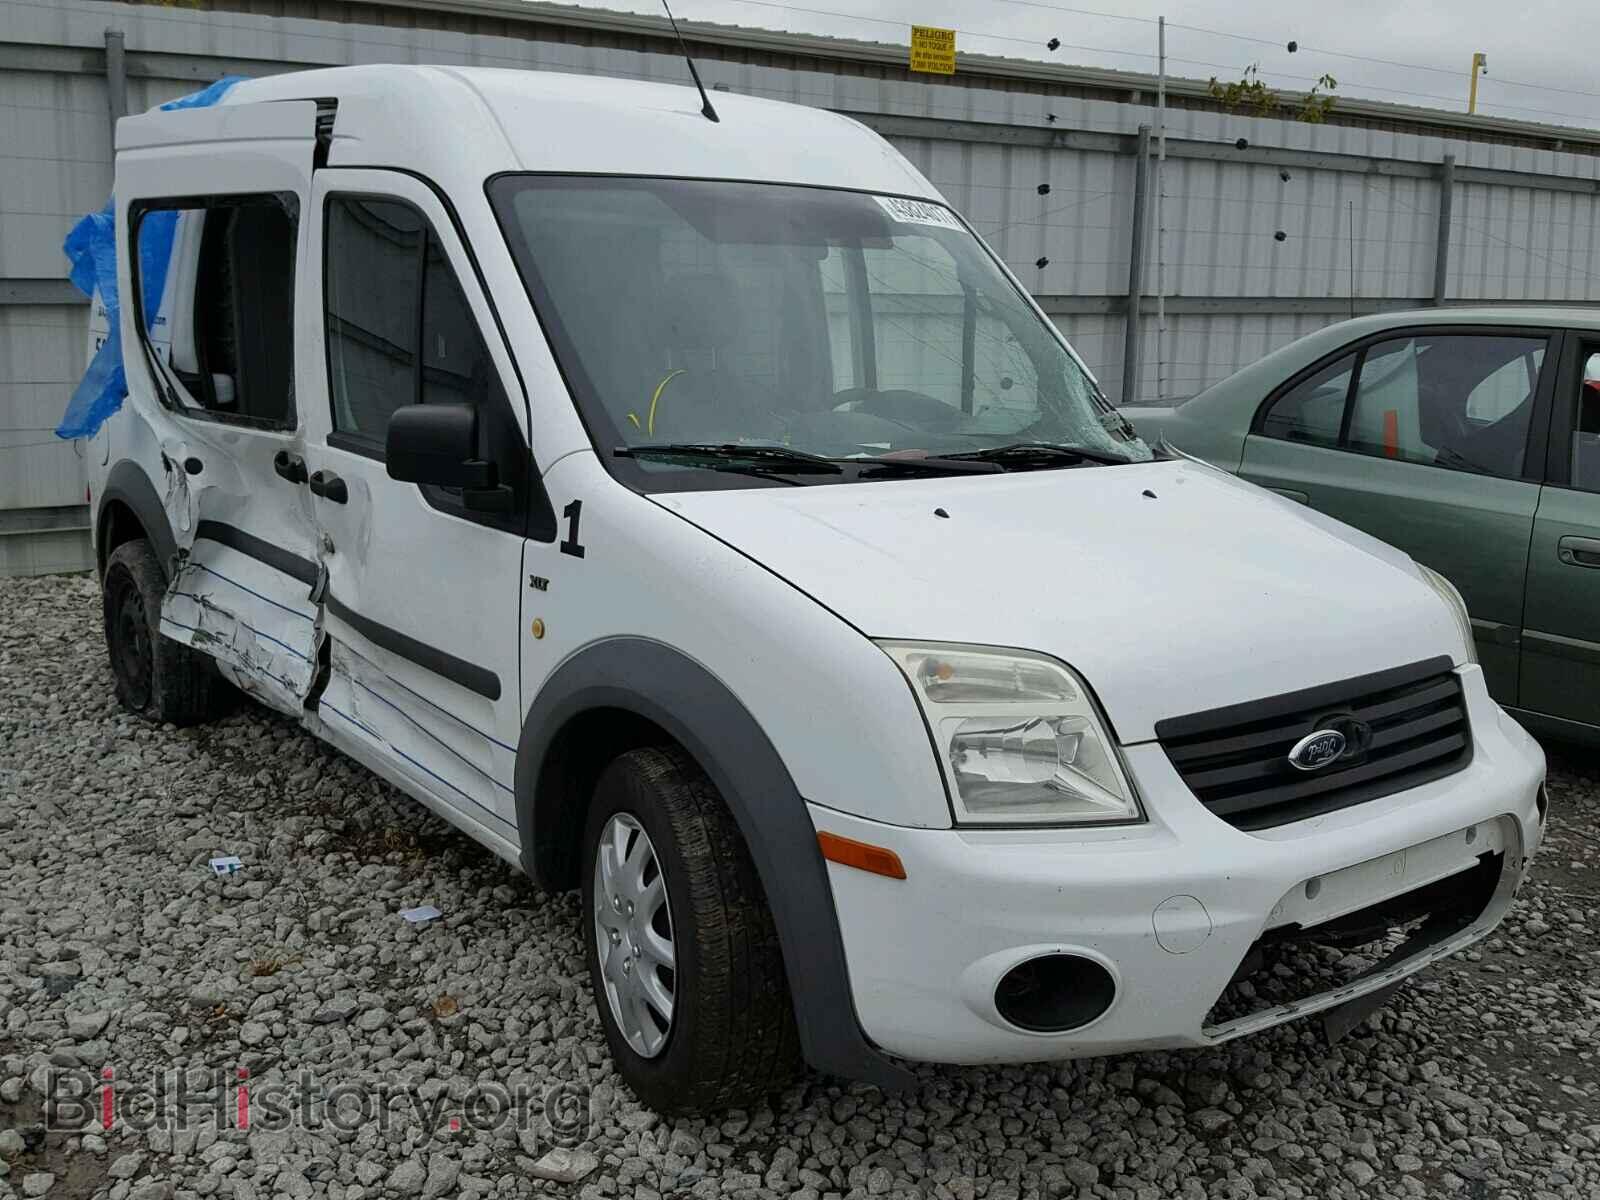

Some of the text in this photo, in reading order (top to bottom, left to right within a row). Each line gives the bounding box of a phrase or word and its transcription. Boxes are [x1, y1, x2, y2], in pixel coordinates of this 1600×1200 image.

[912, 28, 954, 41] PELIGRO
[560, 499, 585, 559] 1
[529, 574, 549, 592] XLT
[1308, 737, 1337, 761] Ford
